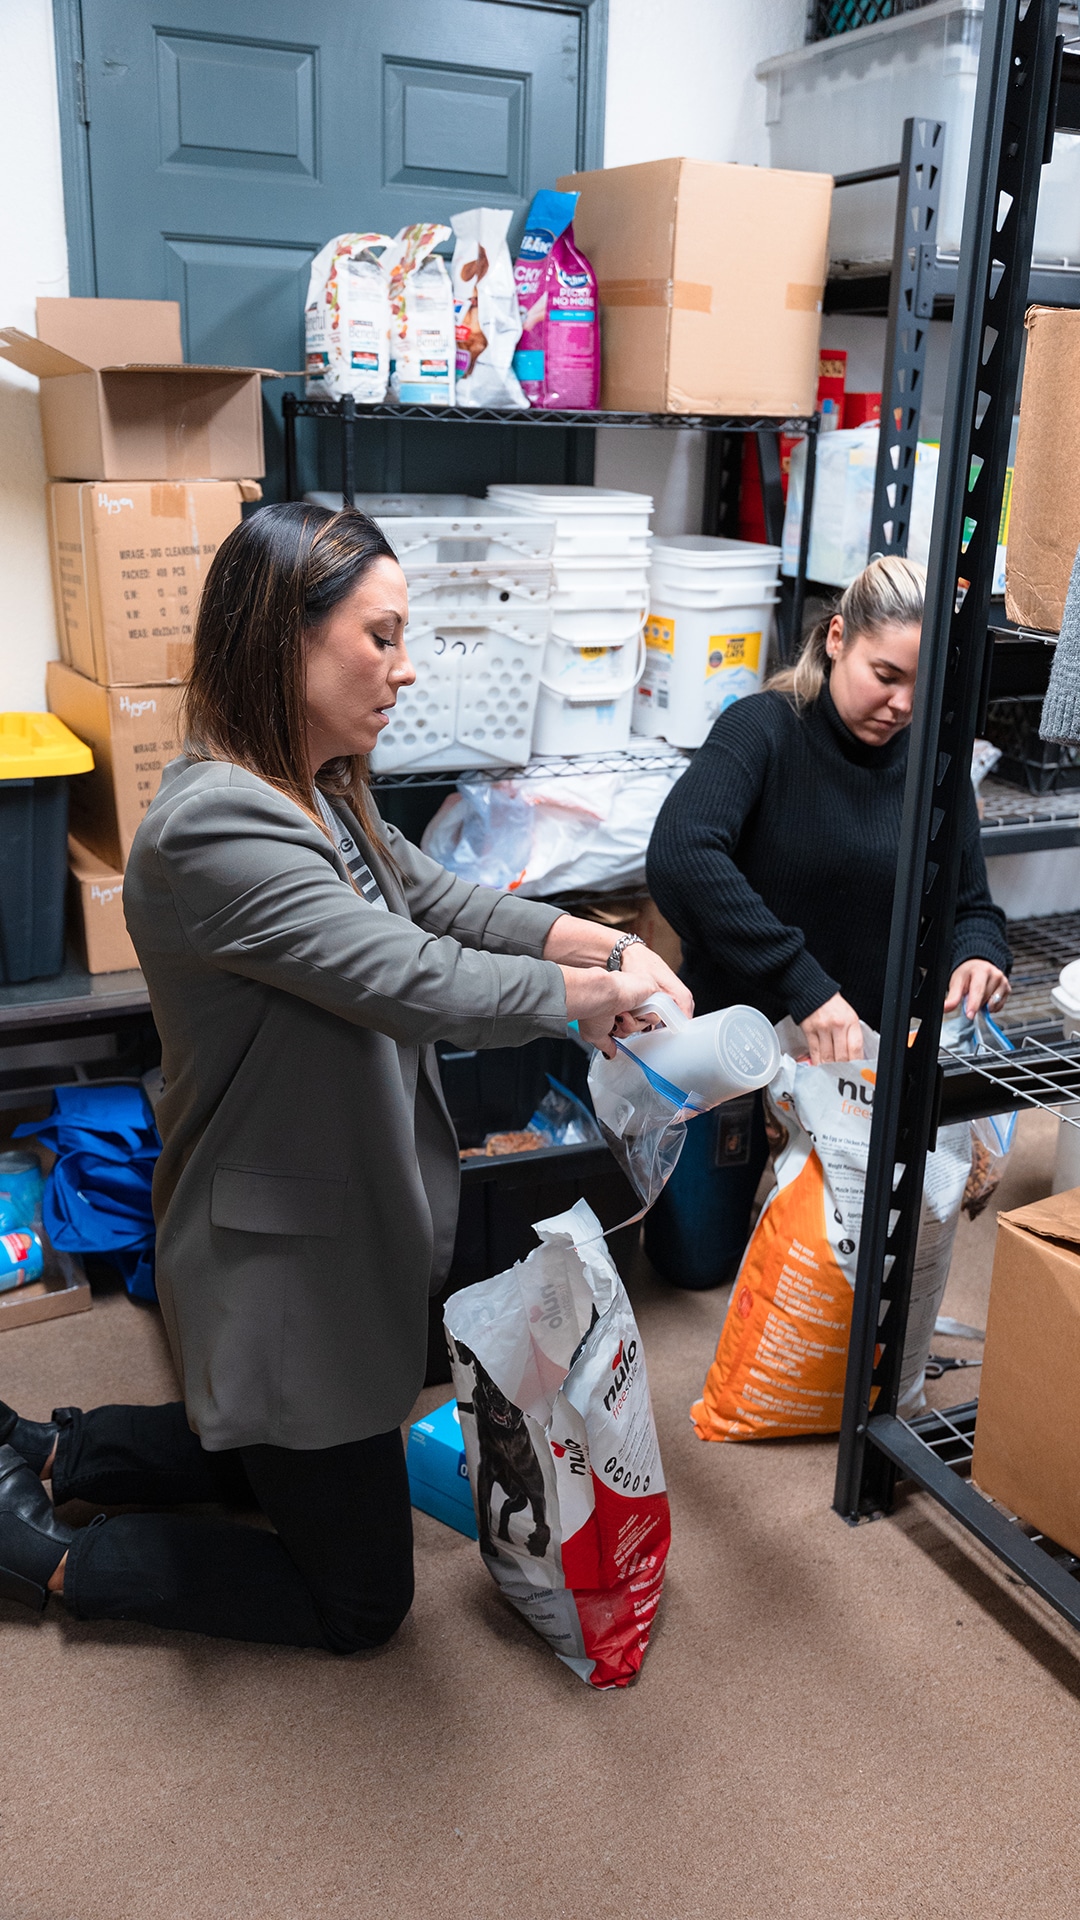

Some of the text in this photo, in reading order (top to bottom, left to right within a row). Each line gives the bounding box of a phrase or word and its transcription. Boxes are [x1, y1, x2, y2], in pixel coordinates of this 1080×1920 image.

[560, 288, 592, 298] PICKY
[552, 298, 594, 306] NO MORE
[165, 545, 200, 557] CLEANSING
[203, 544, 216, 554] BAR
[172, 566, 186, 576] PCS
[178, 586, 187, 596] KG
[180, 605, 190, 615] KG
[724, 650, 746, 659] CATS
[727, 1045, 738, 1059] FREE
[838, 1077, 875, 1106] nu
[844, 1165, 866, 1174] Managemen
[603, 1340, 637, 1412] nulo
[611, 1362, 638, 1420] freestyle
[565, 1439, 587, 1476] nulo
[630, 1581, 650, 1592] Nutrition
[534, 1589, 554, 1599] Protein
